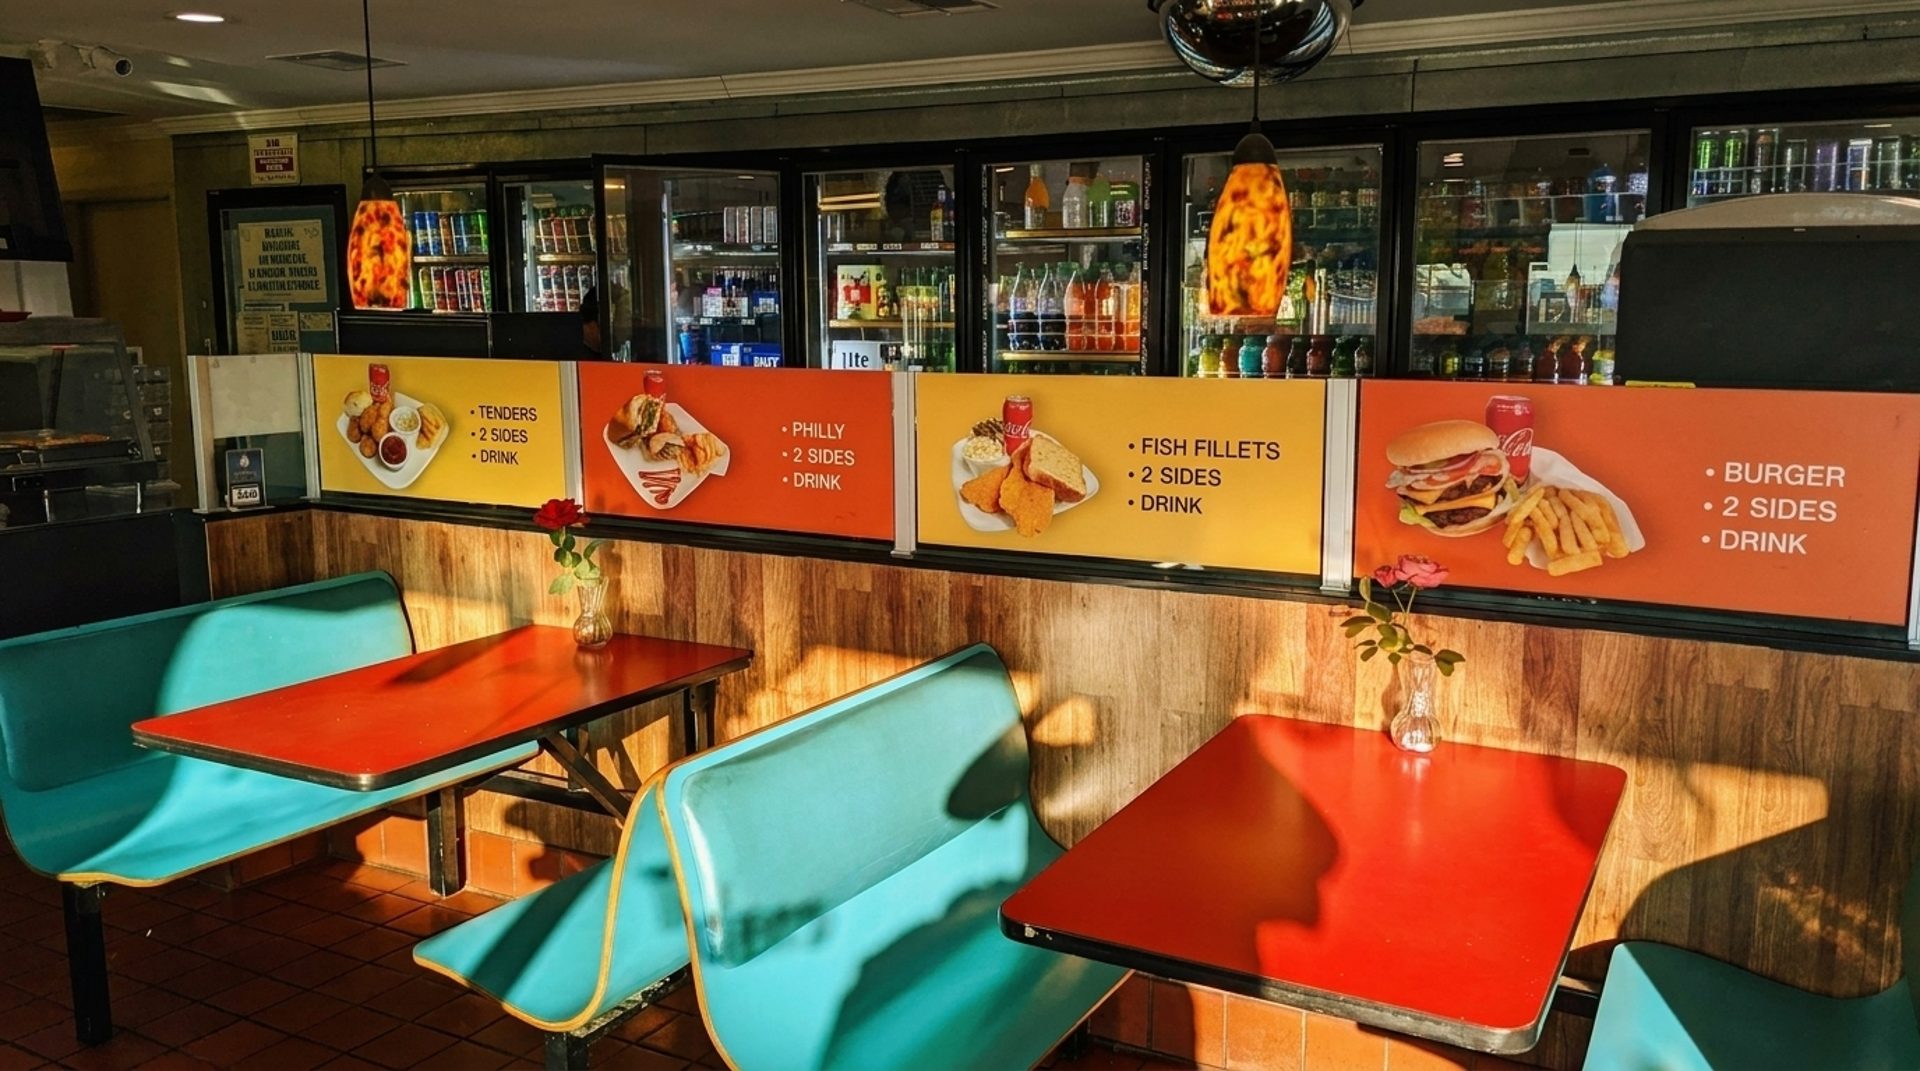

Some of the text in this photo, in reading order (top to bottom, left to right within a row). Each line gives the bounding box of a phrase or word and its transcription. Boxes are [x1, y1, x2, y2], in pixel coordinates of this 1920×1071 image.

[478, 405, 538, 422] TENDERS
[479, 427, 488, 442] 2
[792, 421, 845, 440] PHILLY
[480, 449, 520, 466] DRINK
[793, 447, 856, 467] 2 SIDES
[1142, 437, 1281, 461] FISH FILLETS
[793, 472, 842, 491] DRINK
[1141, 466, 1222, 487] 2 SIDES
[1724, 461, 1846, 488] BURGER
[1141, 494, 1203, 515] DRINK
[1722, 496, 1838, 523] 2 SIDES
[1720, 529, 1808, 556] DRINK
